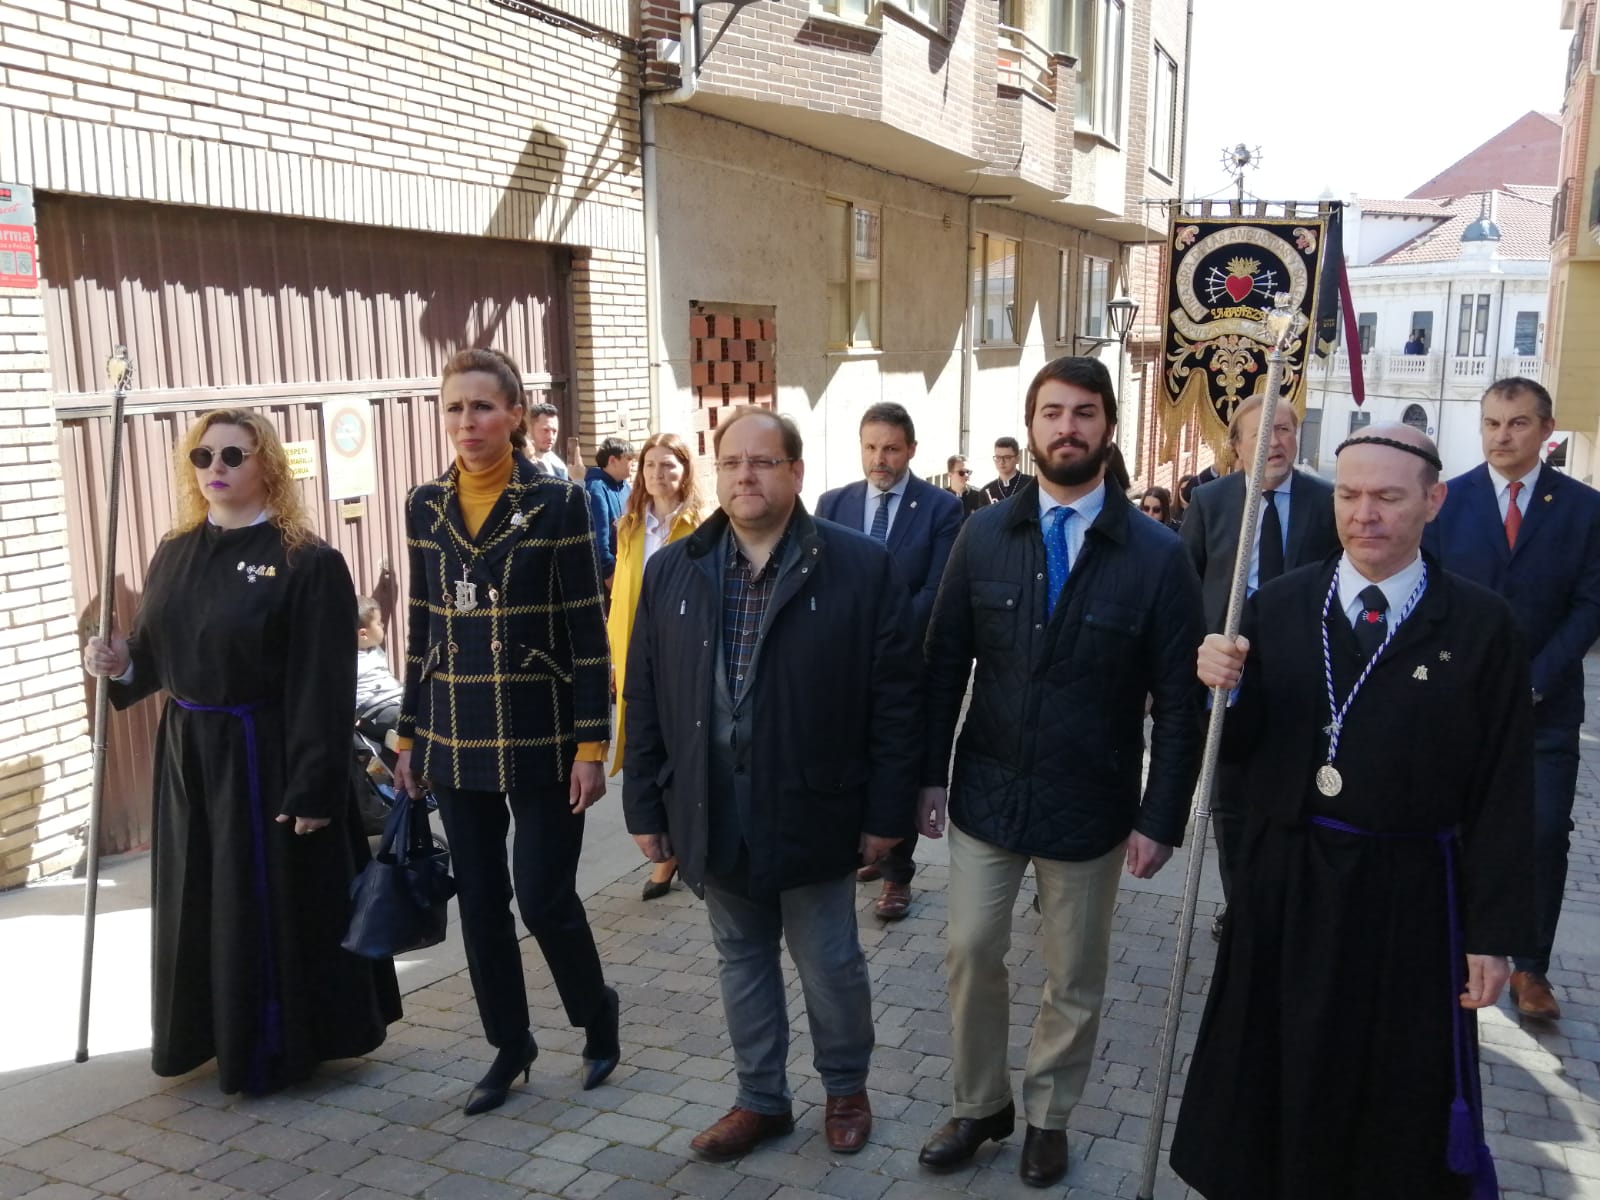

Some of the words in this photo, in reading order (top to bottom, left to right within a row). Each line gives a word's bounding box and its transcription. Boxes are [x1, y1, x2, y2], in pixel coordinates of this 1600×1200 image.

[0, 229, 30, 242] rma
[1204, 234, 1225, 251] LAS
[1228, 229, 1291, 259] ANGUSTIAS
[285, 447, 308, 456] ESPETA
